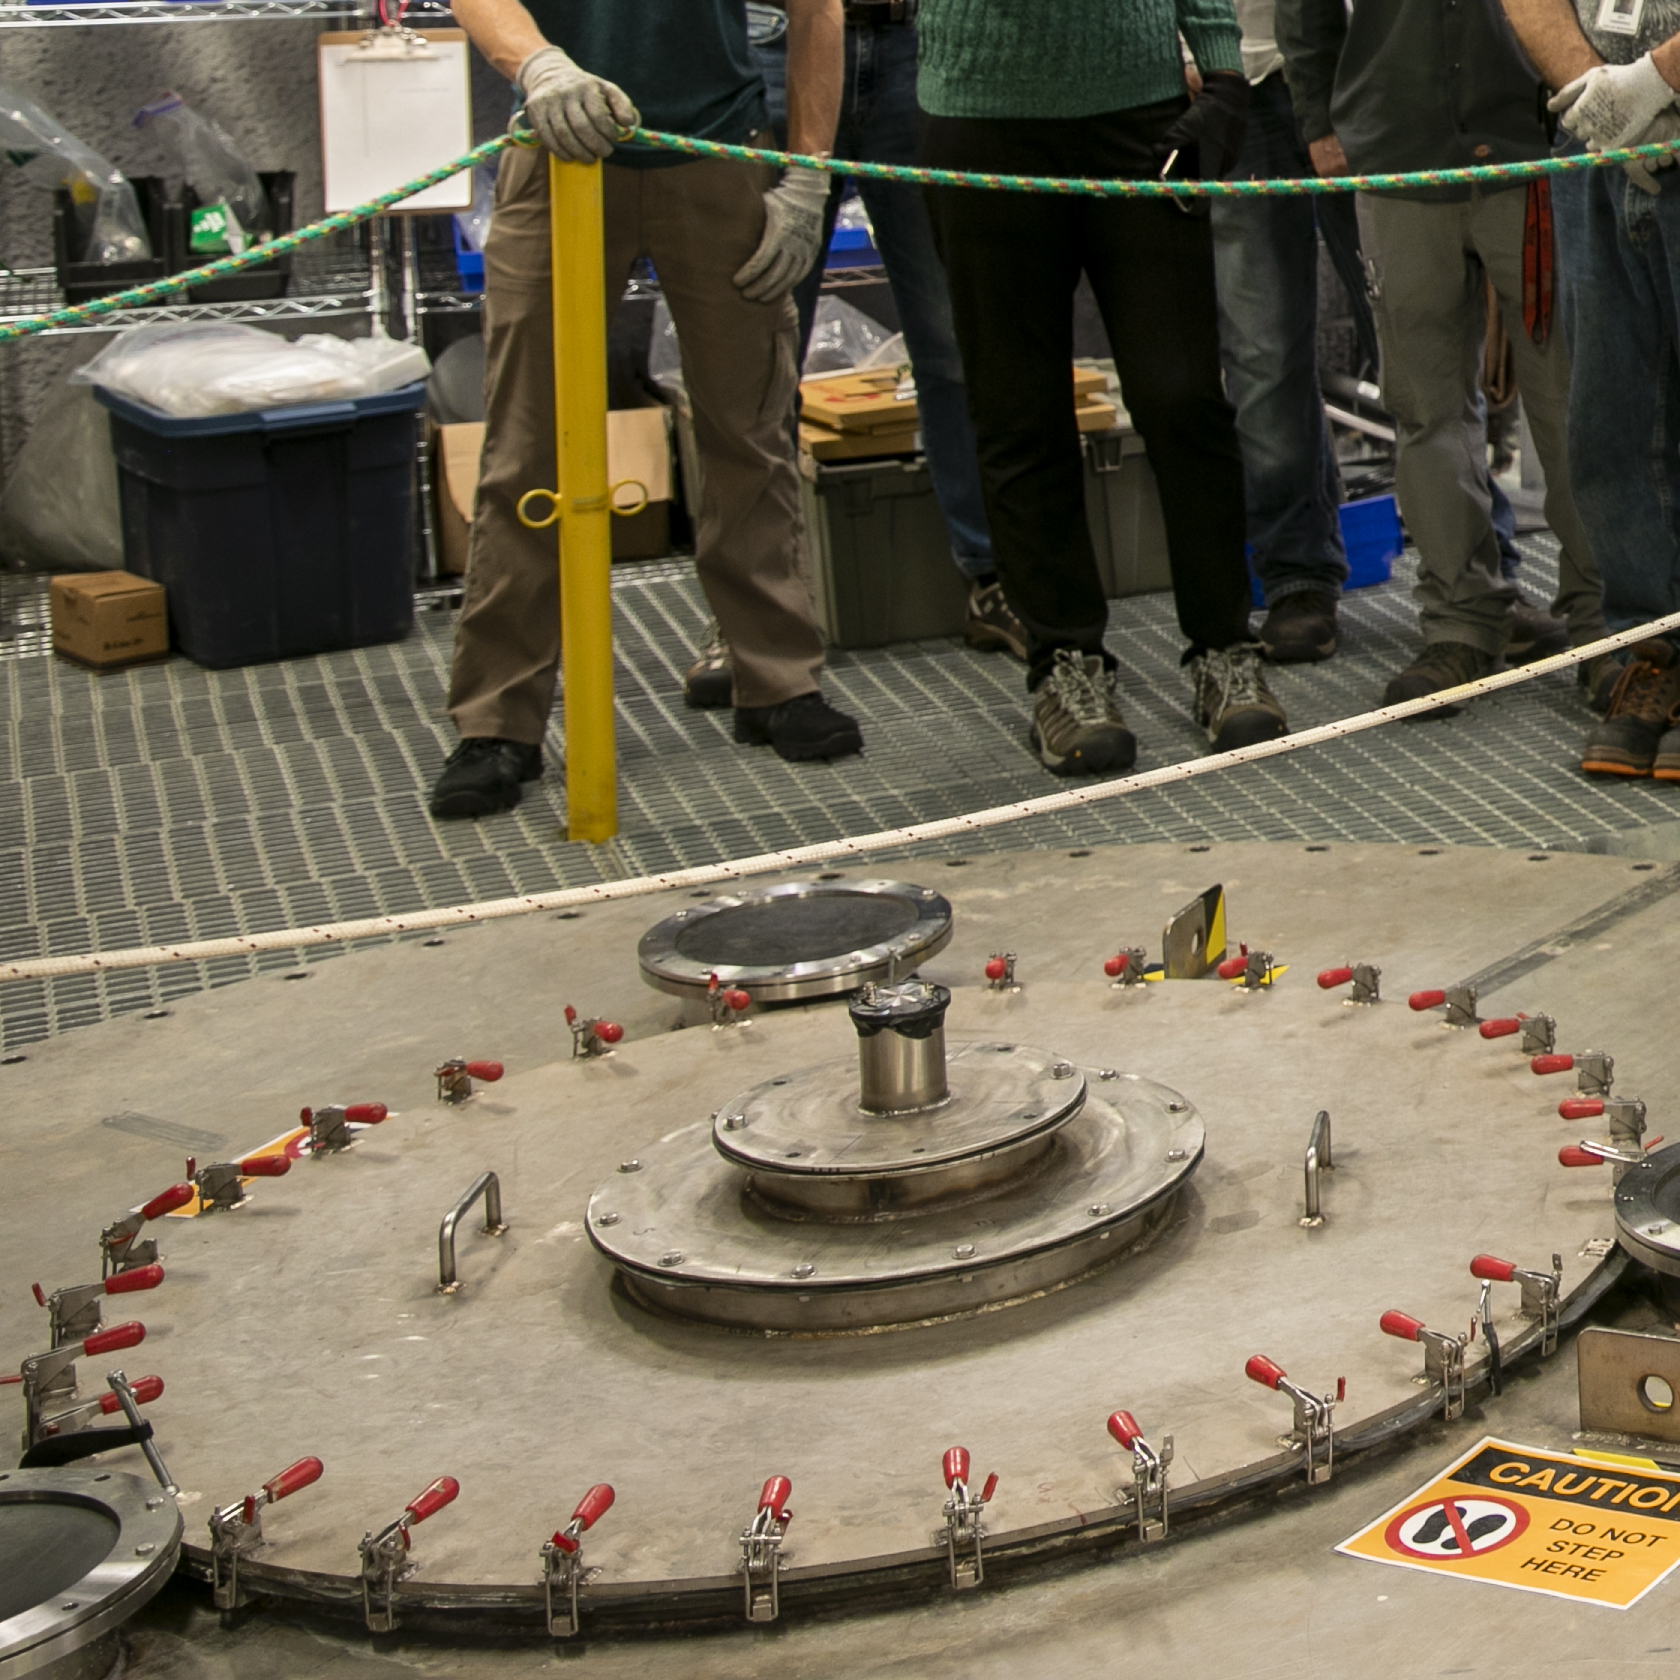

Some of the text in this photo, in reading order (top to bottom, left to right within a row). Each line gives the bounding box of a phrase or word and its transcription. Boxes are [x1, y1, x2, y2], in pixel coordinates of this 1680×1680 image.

[1549, 1517, 1669, 1549] DO NOT
[1545, 1539, 1625, 1563] STEP
[1520, 1557, 1607, 1583] HERE
